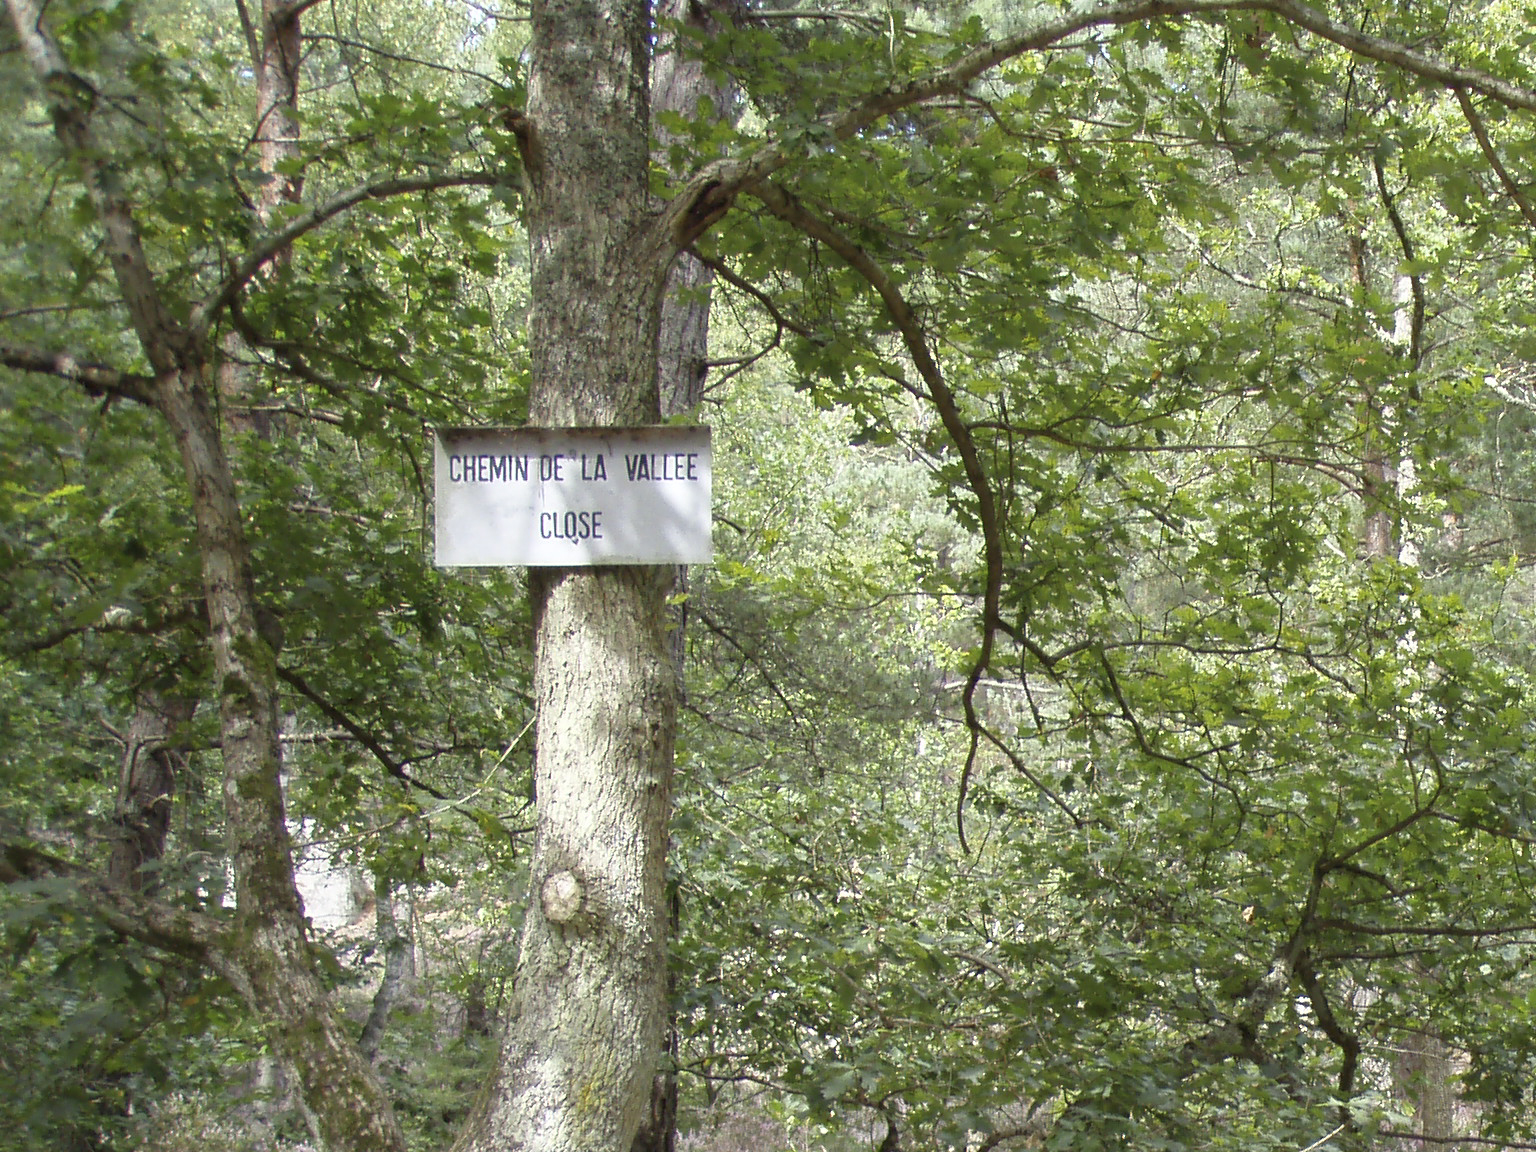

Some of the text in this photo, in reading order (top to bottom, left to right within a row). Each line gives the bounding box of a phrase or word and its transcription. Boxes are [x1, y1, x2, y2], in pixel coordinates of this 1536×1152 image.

[448, 453, 698, 482] CHEMIN DE LA VALLEE
[540, 511, 603, 539] CLOSE
